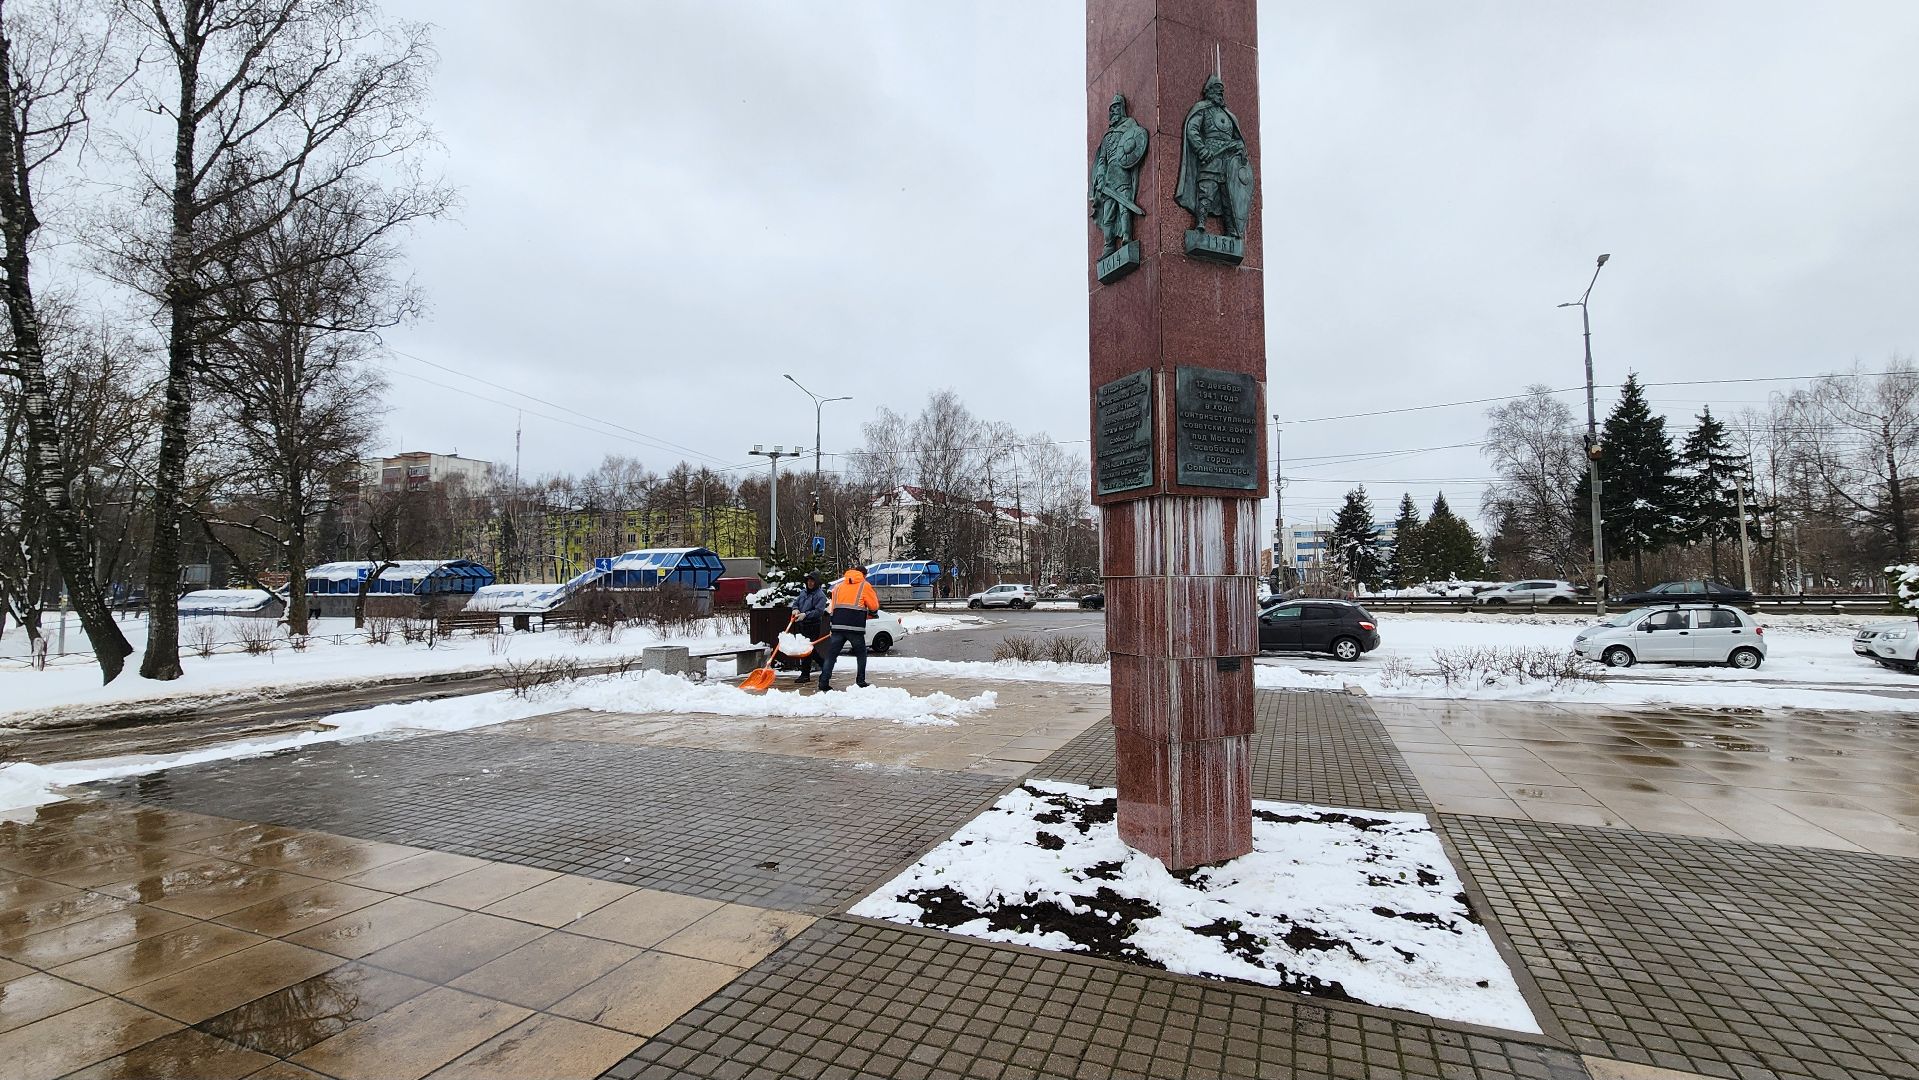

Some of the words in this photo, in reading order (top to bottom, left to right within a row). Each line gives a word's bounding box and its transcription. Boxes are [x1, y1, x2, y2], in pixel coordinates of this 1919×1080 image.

[1195, 380, 1205, 388] 12
[1207, 382, 1242, 393] декабря
[1198, 391, 1217, 400] 1941
[1220, 394, 1239, 403] года
[1213, 404, 1233, 413] ходе
[1183, 421, 1227, 432] советских
[1229, 425, 1253, 435] войск
[1192, 432, 1207, 442] под
[1210, 433, 1246, 445] Москвой
[1206, 455, 1232, 466] город
[1187, 463, 1250, 477] Солнечногорск
